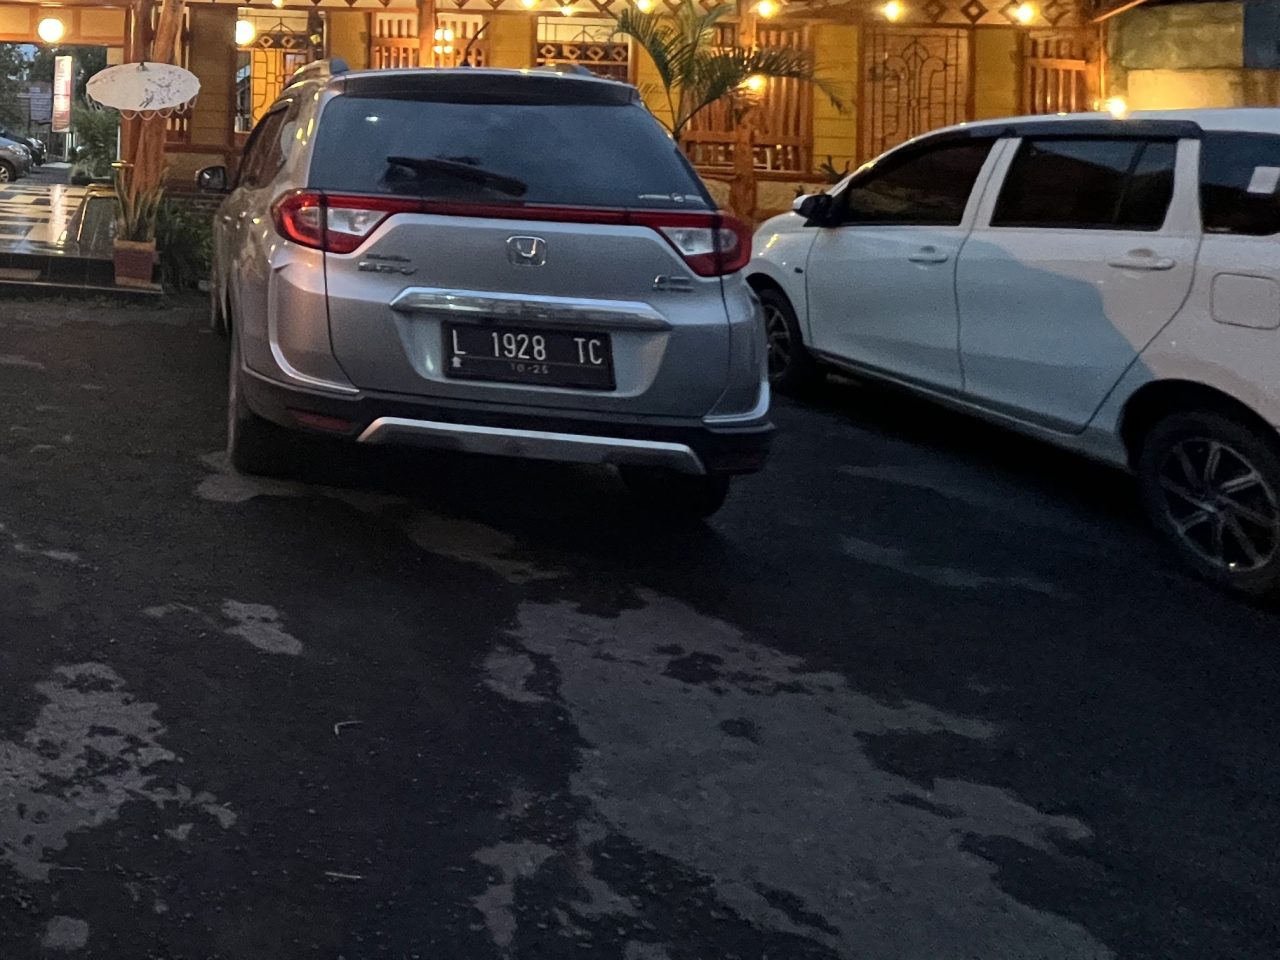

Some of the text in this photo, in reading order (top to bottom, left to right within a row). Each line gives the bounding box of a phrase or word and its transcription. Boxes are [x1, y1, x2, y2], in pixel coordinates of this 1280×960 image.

[452, 329, 603, 365] L 1928 TC
